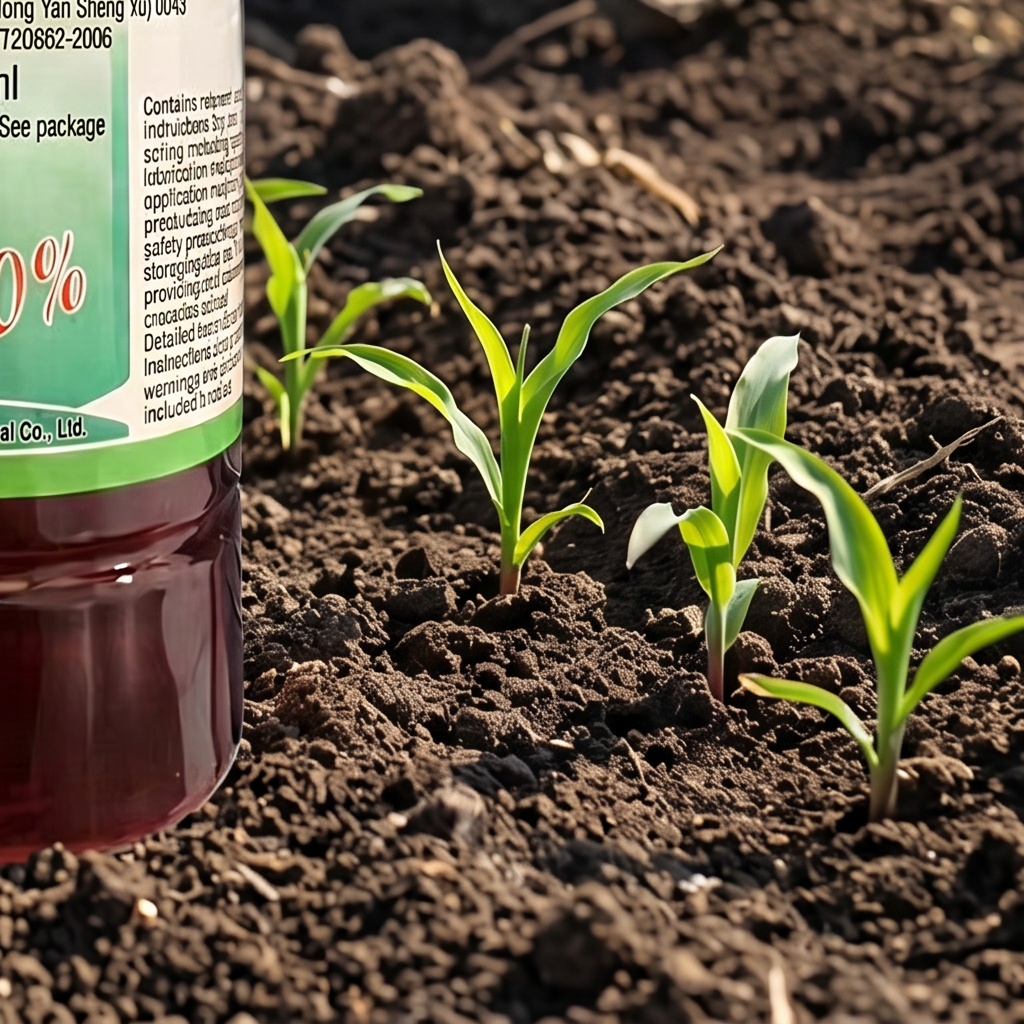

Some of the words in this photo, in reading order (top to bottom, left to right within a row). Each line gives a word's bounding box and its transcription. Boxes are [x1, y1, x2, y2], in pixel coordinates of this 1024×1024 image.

[143, 93, 197, 116] Contains
[36, 113, 106, 142] package
[144, 322, 195, 352] Detailed
[143, 392, 198, 424] included
[20, 420, 52, 442] Co.,
[58, 416, 87, 438] Ltd.
